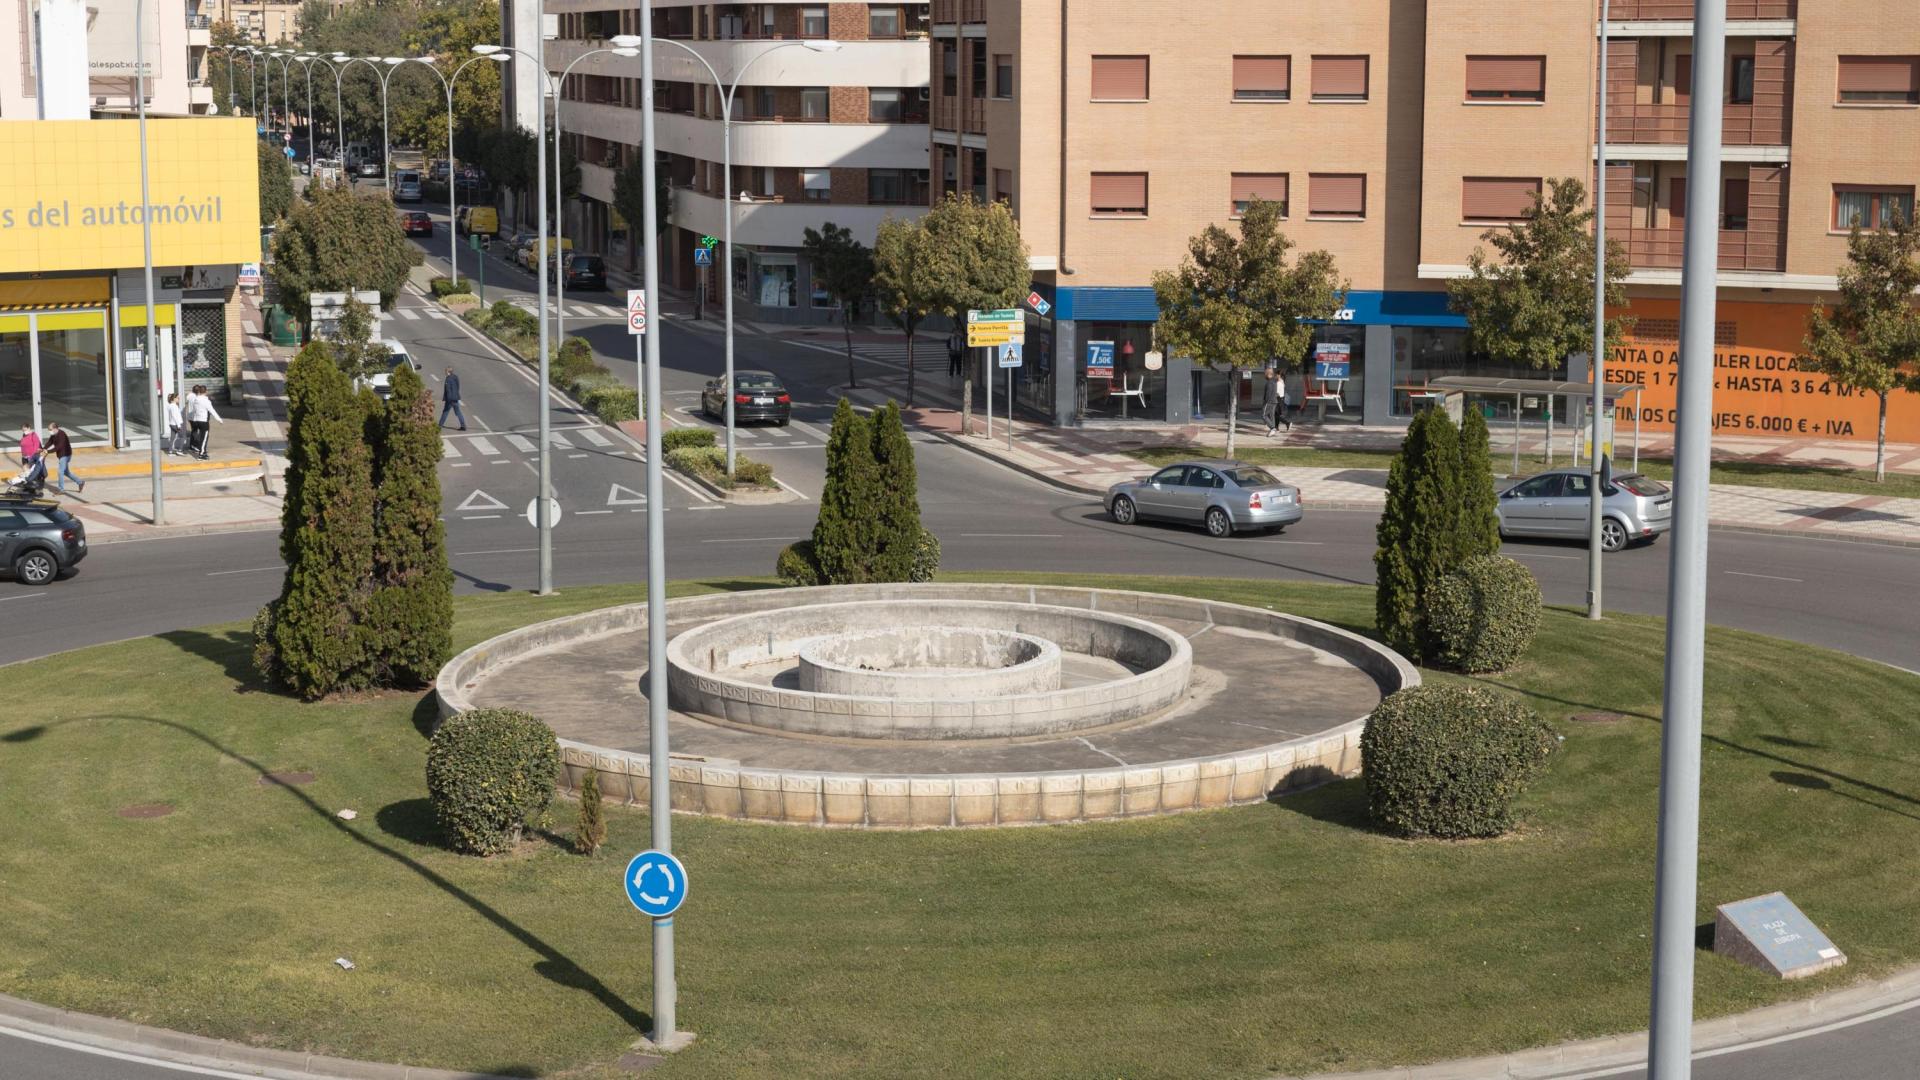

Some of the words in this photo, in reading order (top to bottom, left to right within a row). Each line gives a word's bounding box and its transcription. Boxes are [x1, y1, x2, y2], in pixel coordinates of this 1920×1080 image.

[28, 200, 69, 227] del
[82, 196, 222, 226] automóvil
[634, 317, 644, 325] 30
[1653, 350, 1664, 364] O
[1727, 376, 1783, 393] HASTA
[1746, 415, 1793, 432] 6.000
[1797, 418, 1807, 432] €
[1826, 419, 1854, 436] IVA
